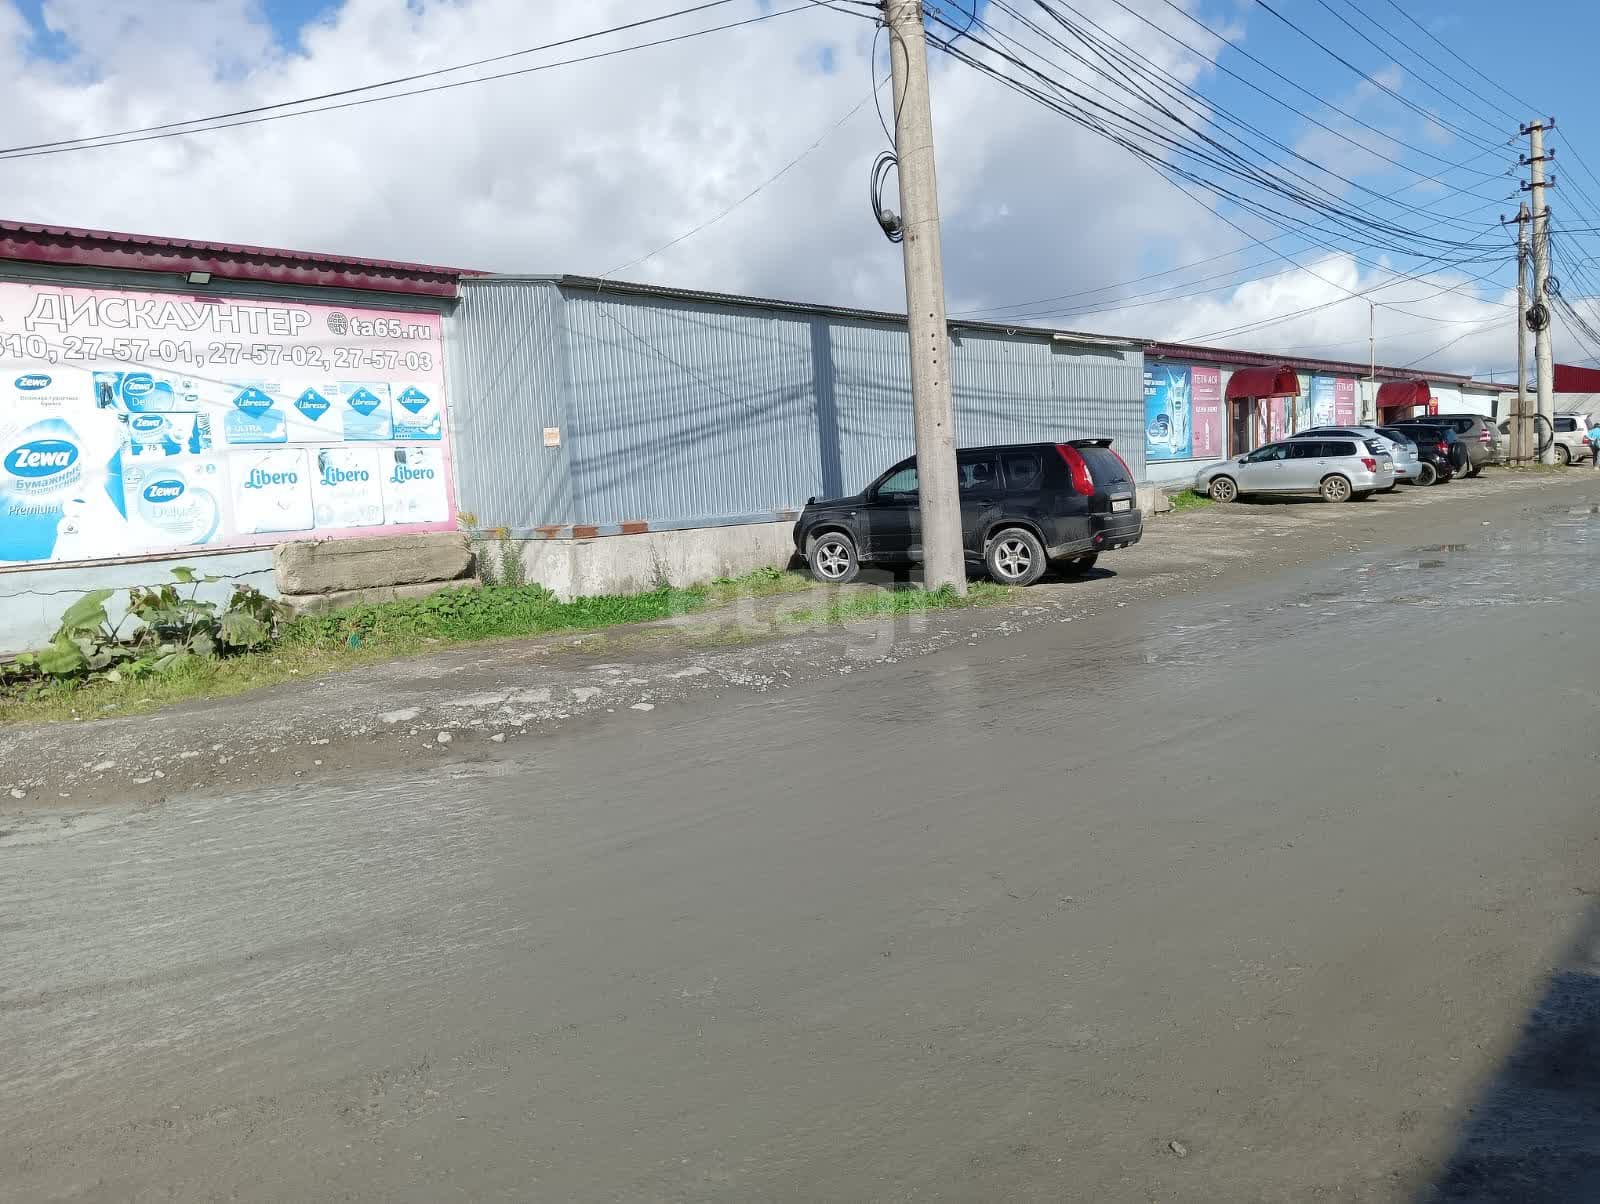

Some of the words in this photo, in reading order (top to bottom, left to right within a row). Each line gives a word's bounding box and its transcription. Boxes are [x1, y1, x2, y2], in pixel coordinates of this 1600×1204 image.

[25, 293, 312, 338] ДИСКАУНТЕР
[350, 316, 432, 341] ta65.ru
[334, 347, 433, 373] 27-57-03
[19, 377, 48, 387] Zewa
[128, 381, 153, 392] Zewa
[137, 417, 162, 428] Zewa
[15, 448, 71, 468] Zewa
[244, 468, 298, 489] Libero
[320, 466, 369, 486] Libero
[389, 464, 435, 484] Libero
[149, 485, 180, 497] Zewa
